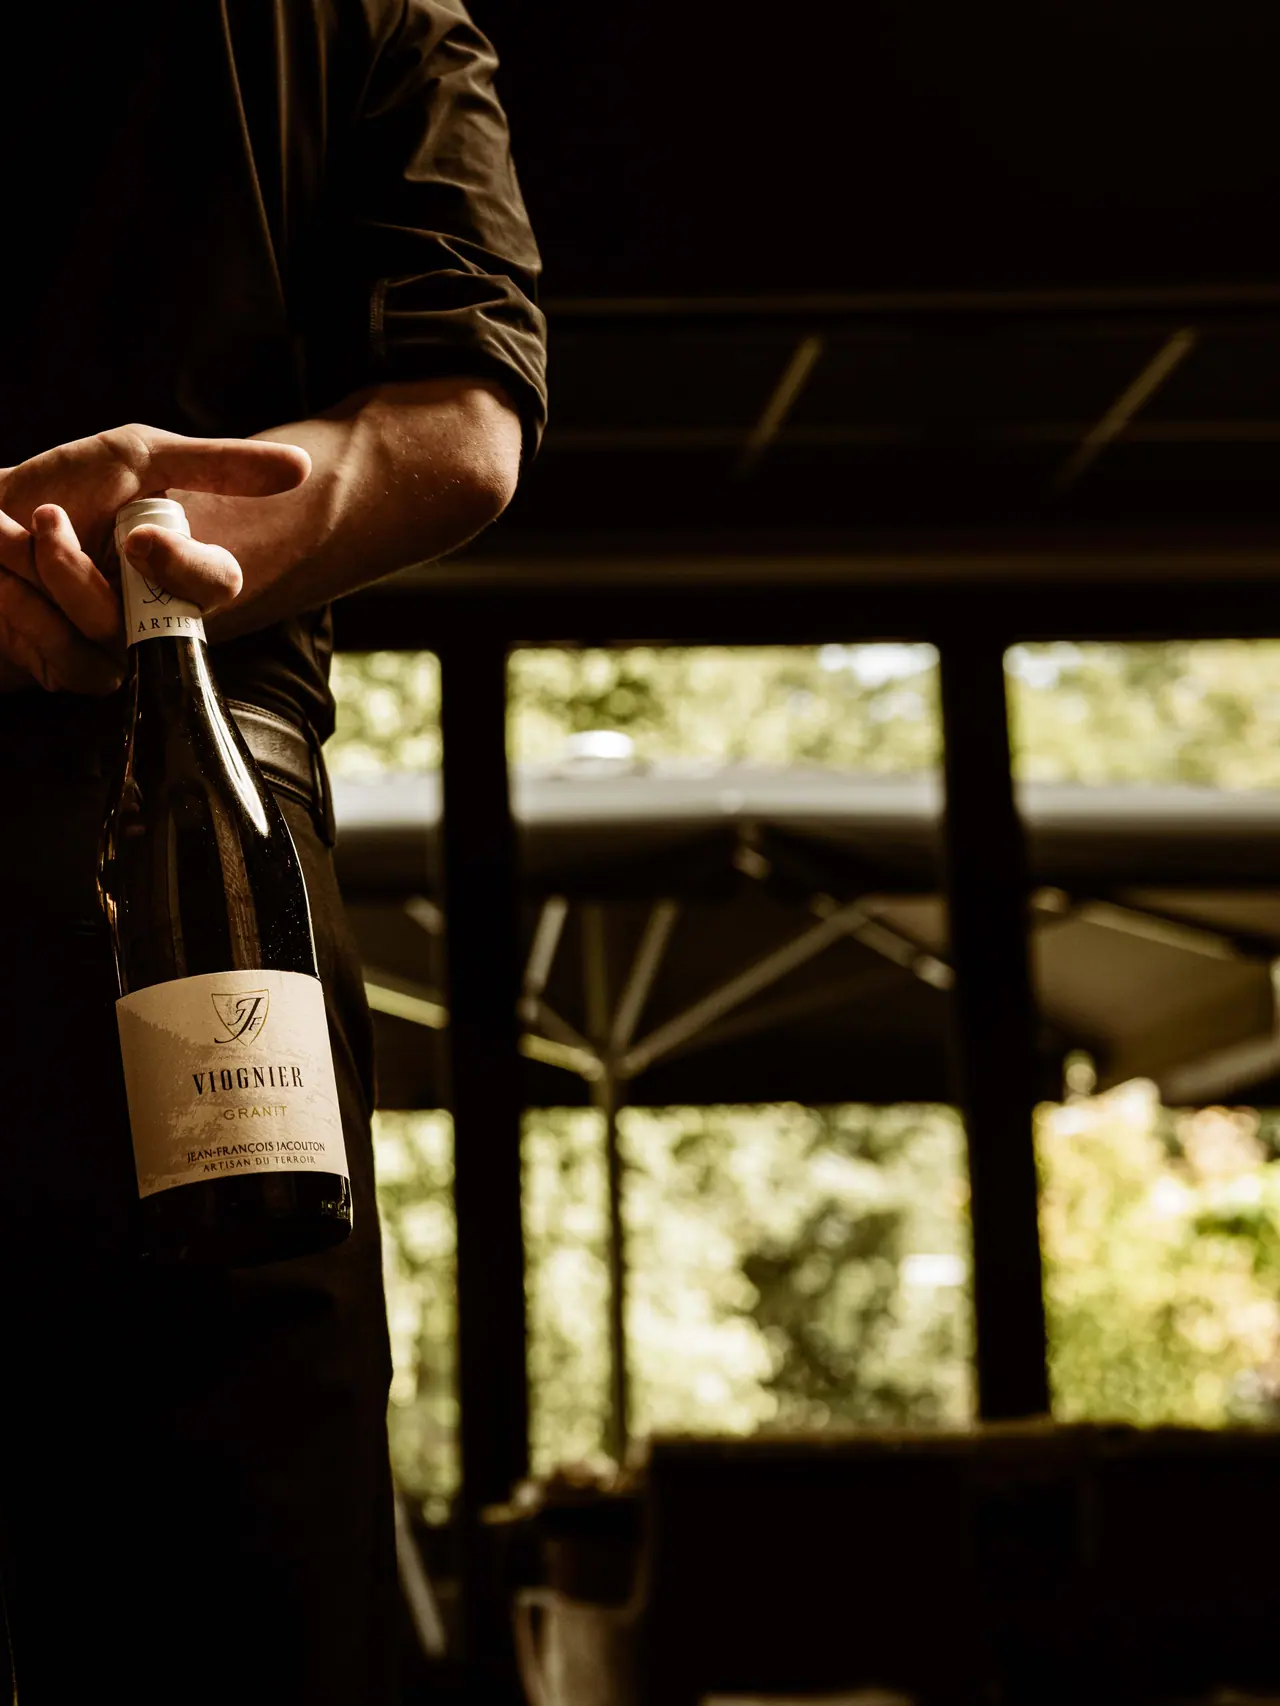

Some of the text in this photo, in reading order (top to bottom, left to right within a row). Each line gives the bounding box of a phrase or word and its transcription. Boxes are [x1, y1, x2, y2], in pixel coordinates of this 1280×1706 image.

[192, 1066, 304, 1095] VIOGNIER
[223, 1105, 287, 1120] GRANIT
[186, 1141, 326, 1163] JEAN-FRANÇOIS JACOUTON
[203, 1155, 316, 1172] ARTISAN DU TERROIR
